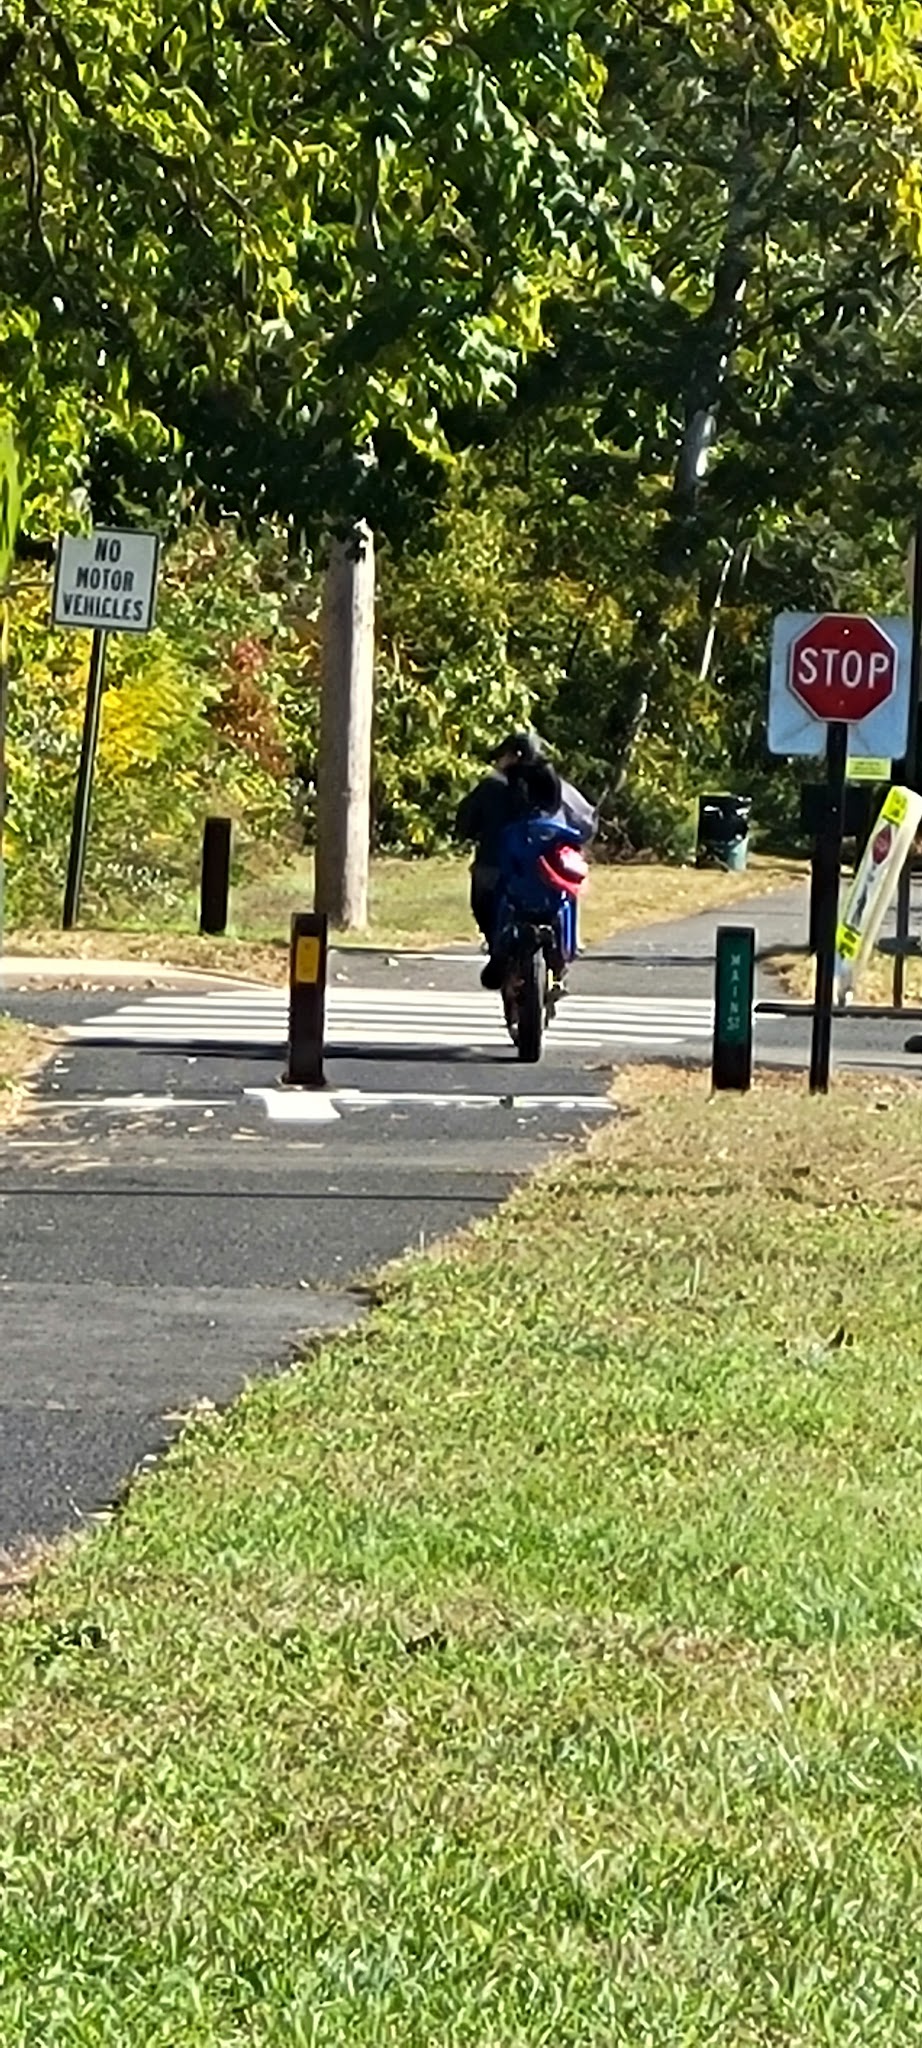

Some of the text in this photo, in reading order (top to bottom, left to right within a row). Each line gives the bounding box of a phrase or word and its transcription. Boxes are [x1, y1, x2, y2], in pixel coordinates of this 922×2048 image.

[95, 538, 122, 562] NO
[76, 567, 134, 592] MOTOR
[63, 593, 143, 621] VEHICLES
[798, 647, 889, 689] STOP
[729, 954, 742, 1014] MAIN
